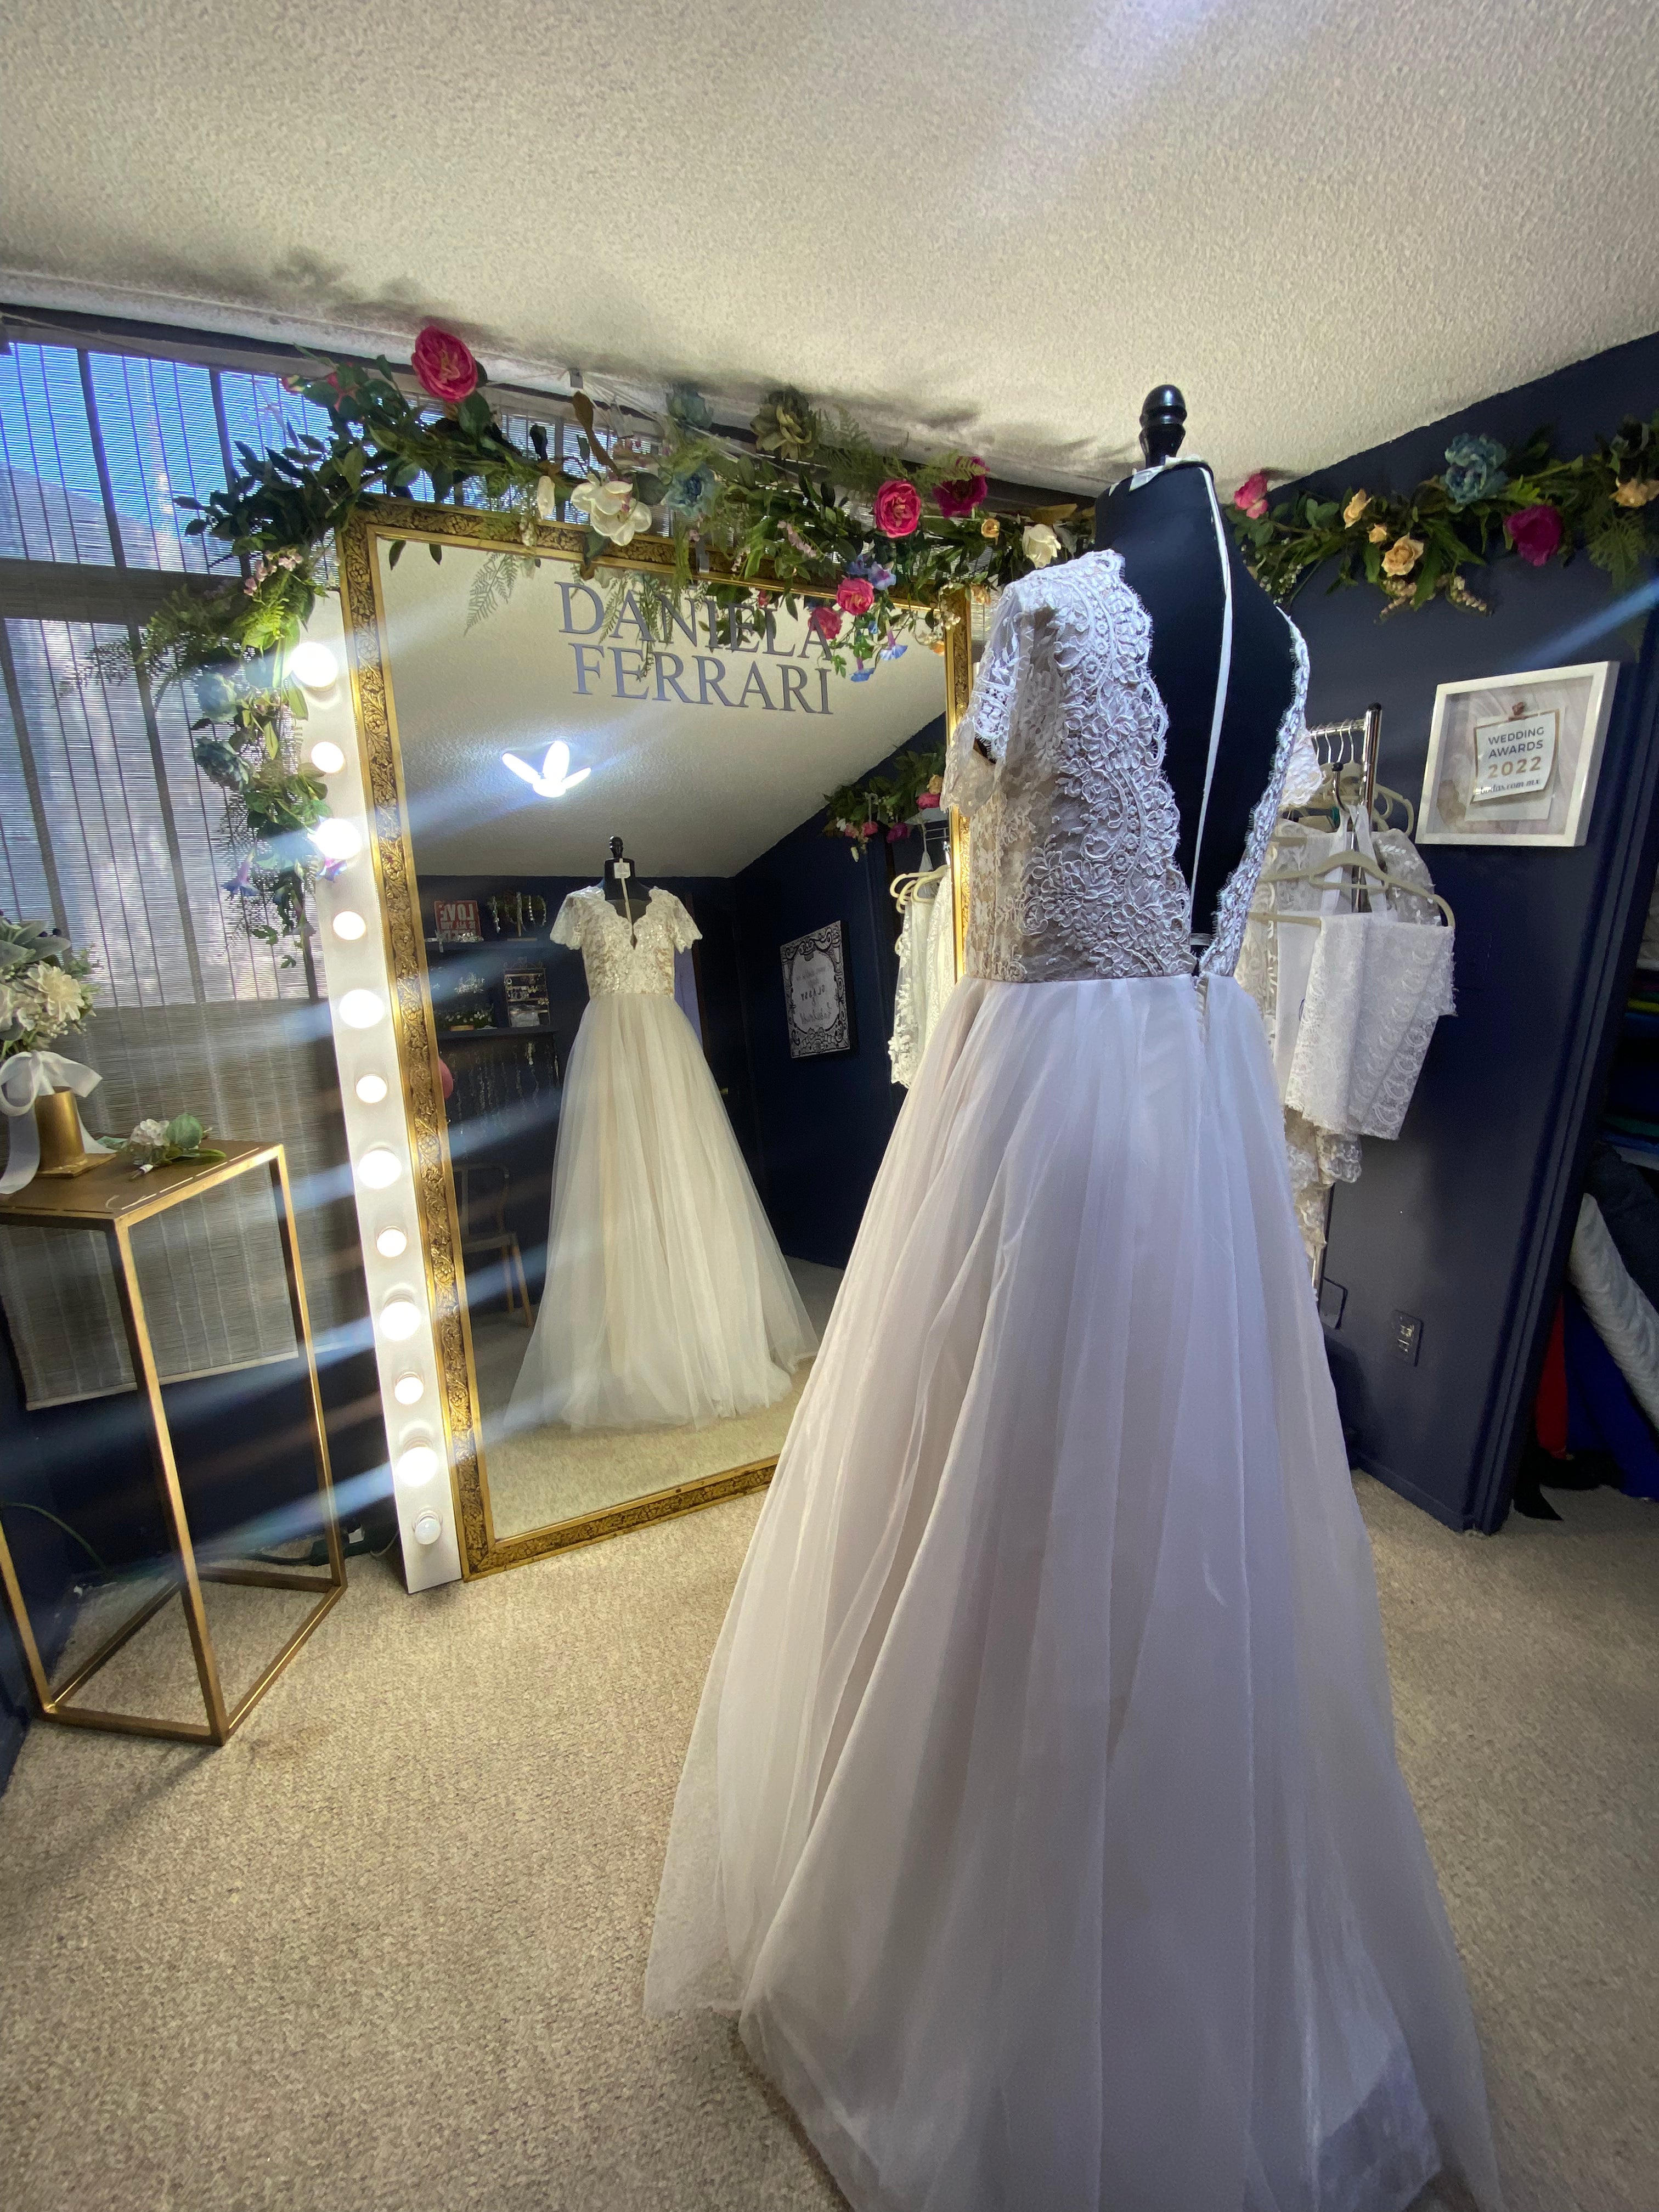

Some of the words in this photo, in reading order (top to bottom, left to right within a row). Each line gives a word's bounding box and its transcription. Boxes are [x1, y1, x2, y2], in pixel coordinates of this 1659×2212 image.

[554, 581, 833, 661] DANIELA
[568, 642, 834, 715] FERRARI
[1488, 725, 1545, 745] WEDDING
[1488, 740, 1543, 759] AWARDS
[1487, 756, 1542, 779] 2022
